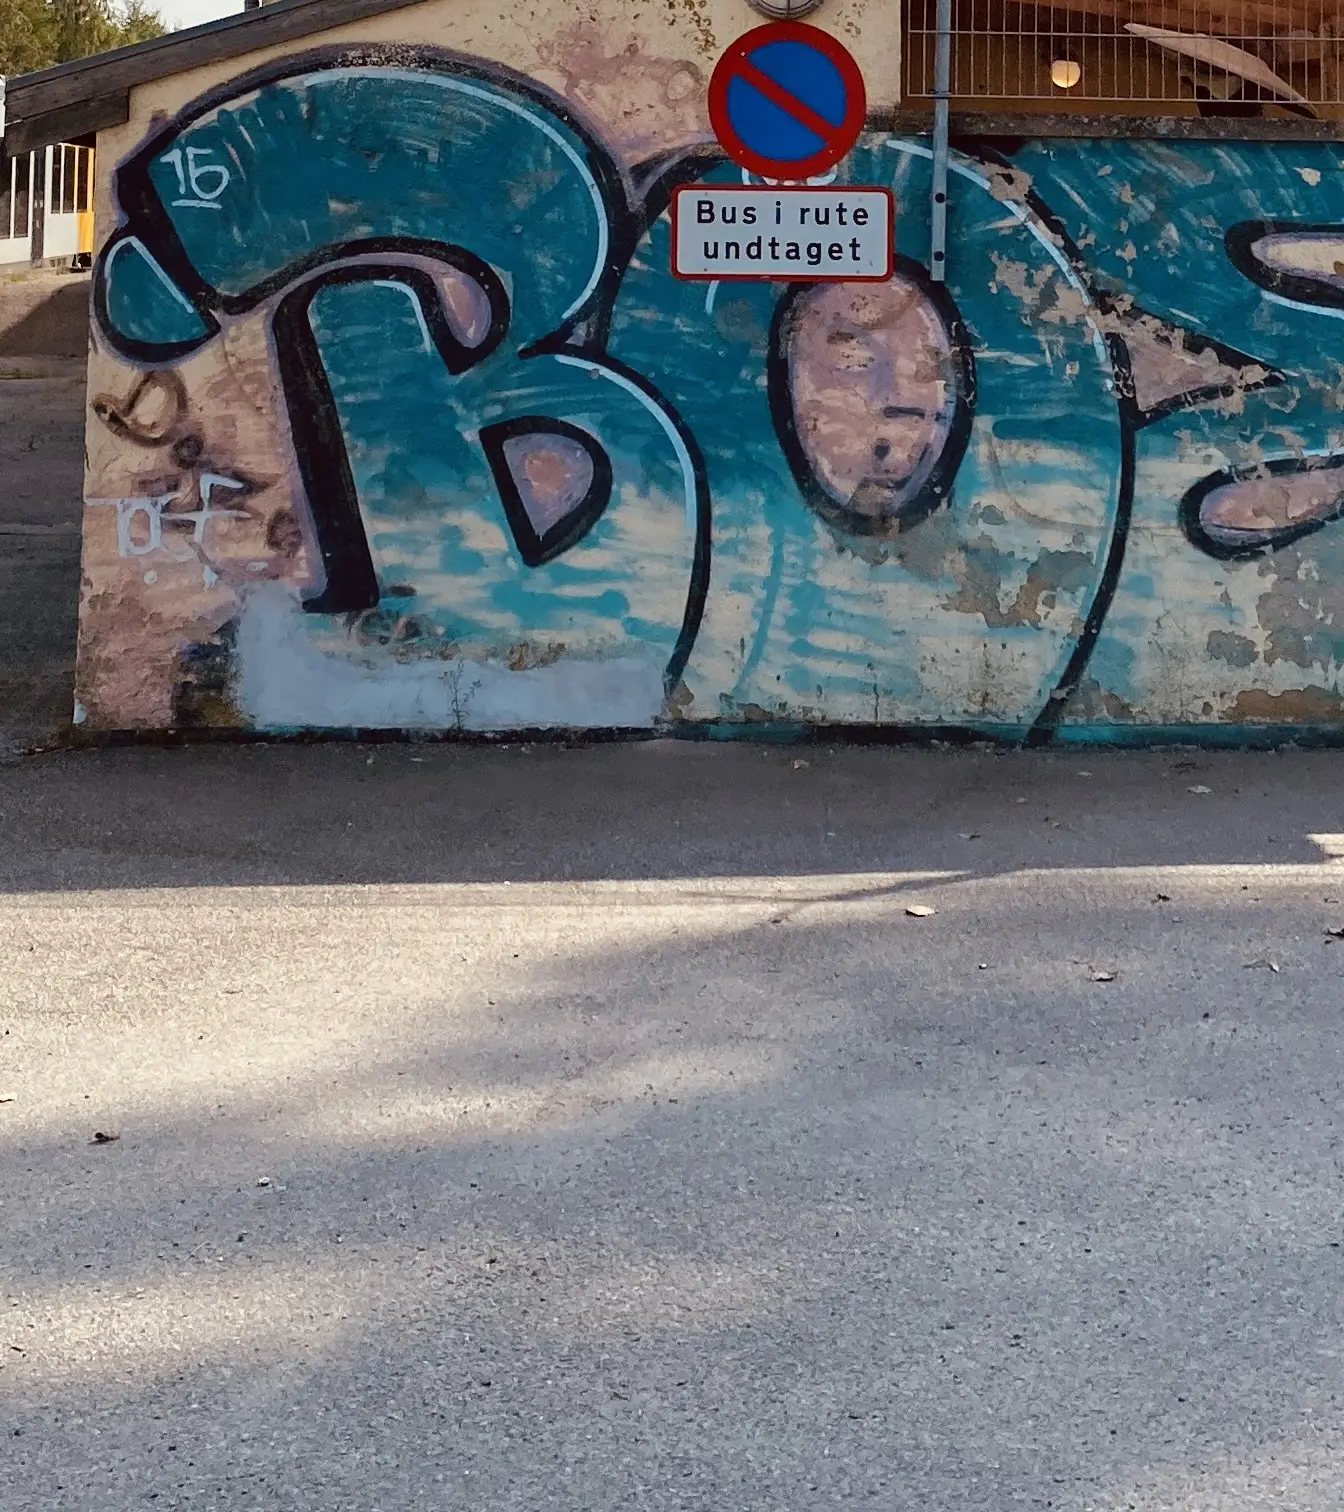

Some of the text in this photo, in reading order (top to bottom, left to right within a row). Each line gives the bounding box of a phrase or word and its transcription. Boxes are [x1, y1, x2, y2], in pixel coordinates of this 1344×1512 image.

[696, 200, 870, 226] Bus i rute
[703, 235, 862, 266] undtaget
